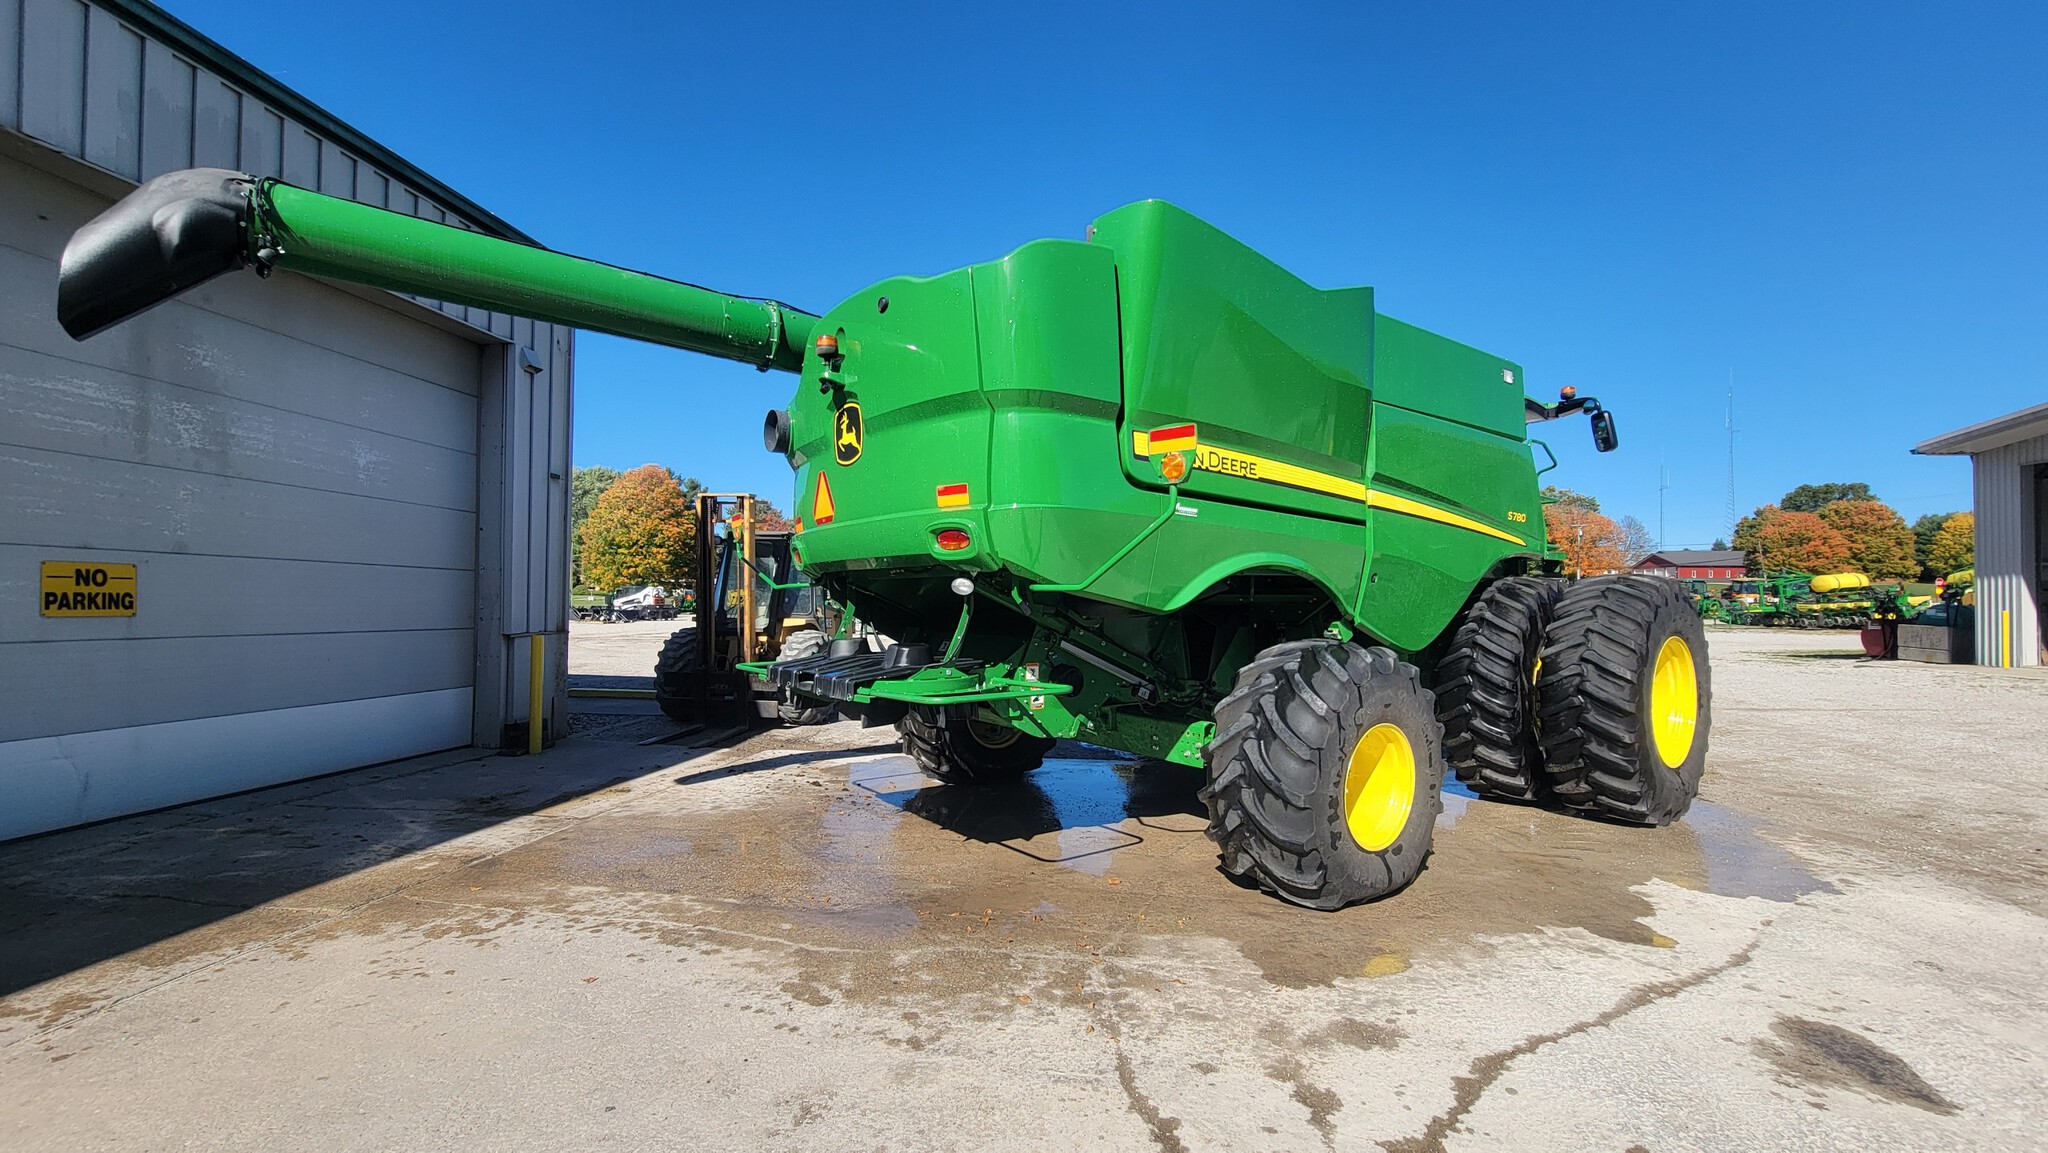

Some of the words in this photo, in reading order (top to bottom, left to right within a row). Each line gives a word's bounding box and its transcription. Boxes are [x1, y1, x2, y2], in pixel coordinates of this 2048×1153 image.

[1209, 451, 1258, 476] DEERE
[1507, 511, 1527, 523] S780
[75, 568, 108, 587] NO
[44, 592, 134, 610] PARKING
